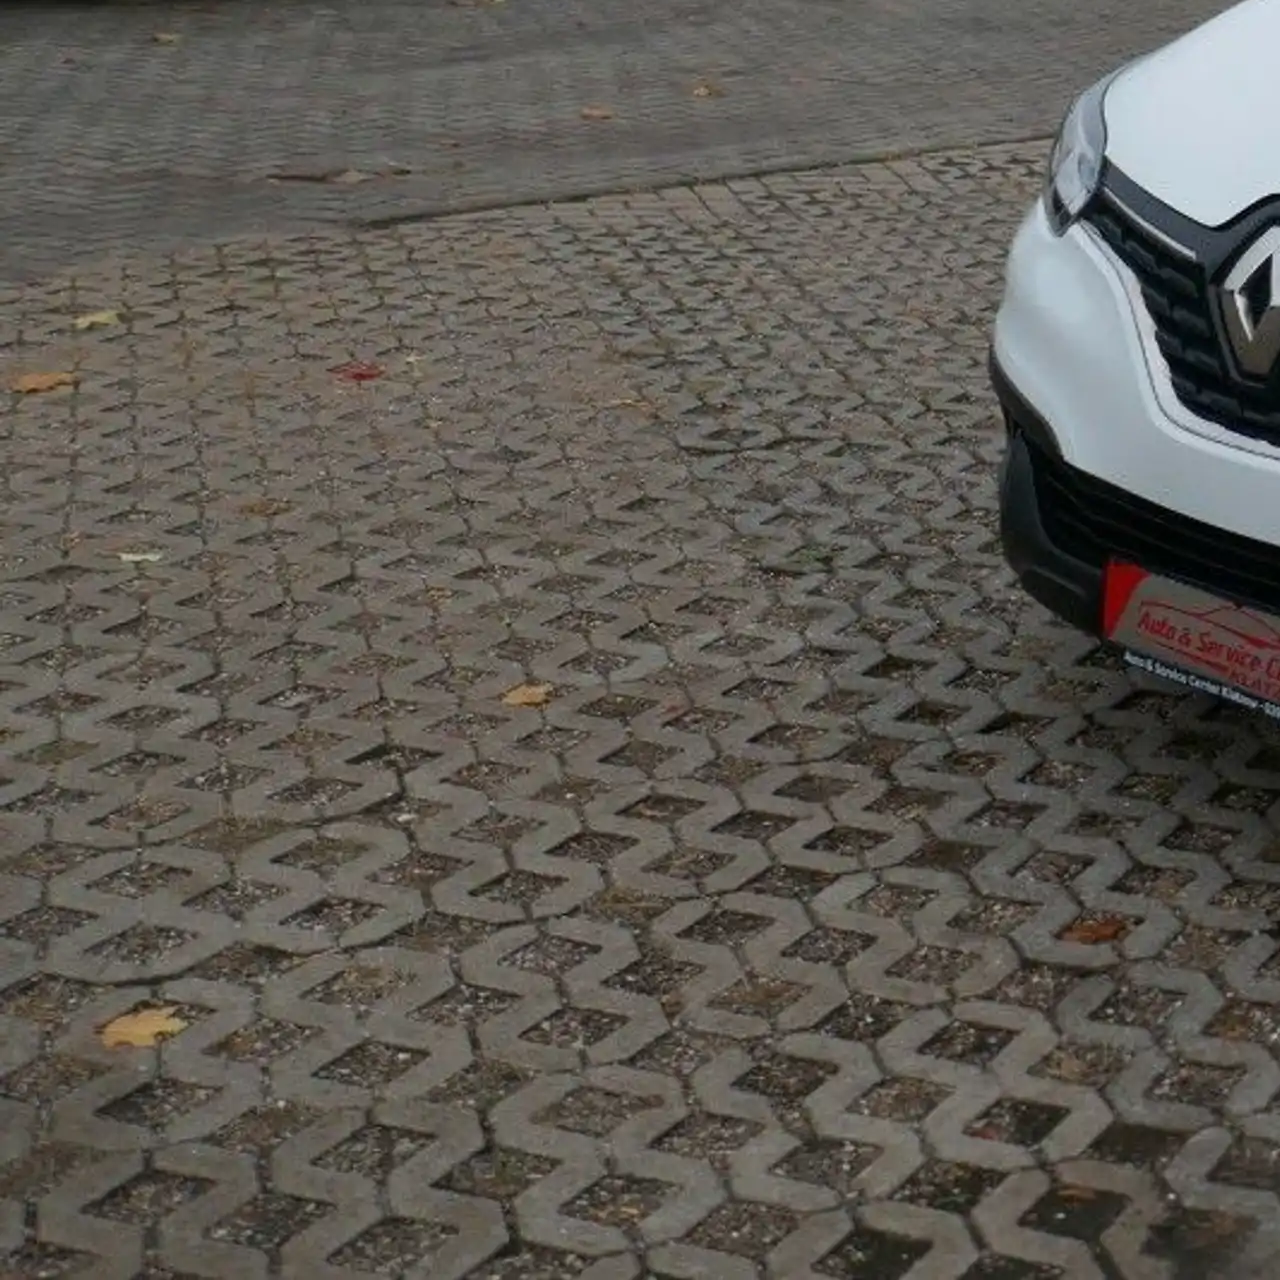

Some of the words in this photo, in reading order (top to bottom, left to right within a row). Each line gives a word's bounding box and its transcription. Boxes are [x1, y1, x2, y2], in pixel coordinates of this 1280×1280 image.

[1137, 610, 1176, 643] Auto
[1177, 626, 1193, 648] &
[1197, 630, 1263, 672] Service
